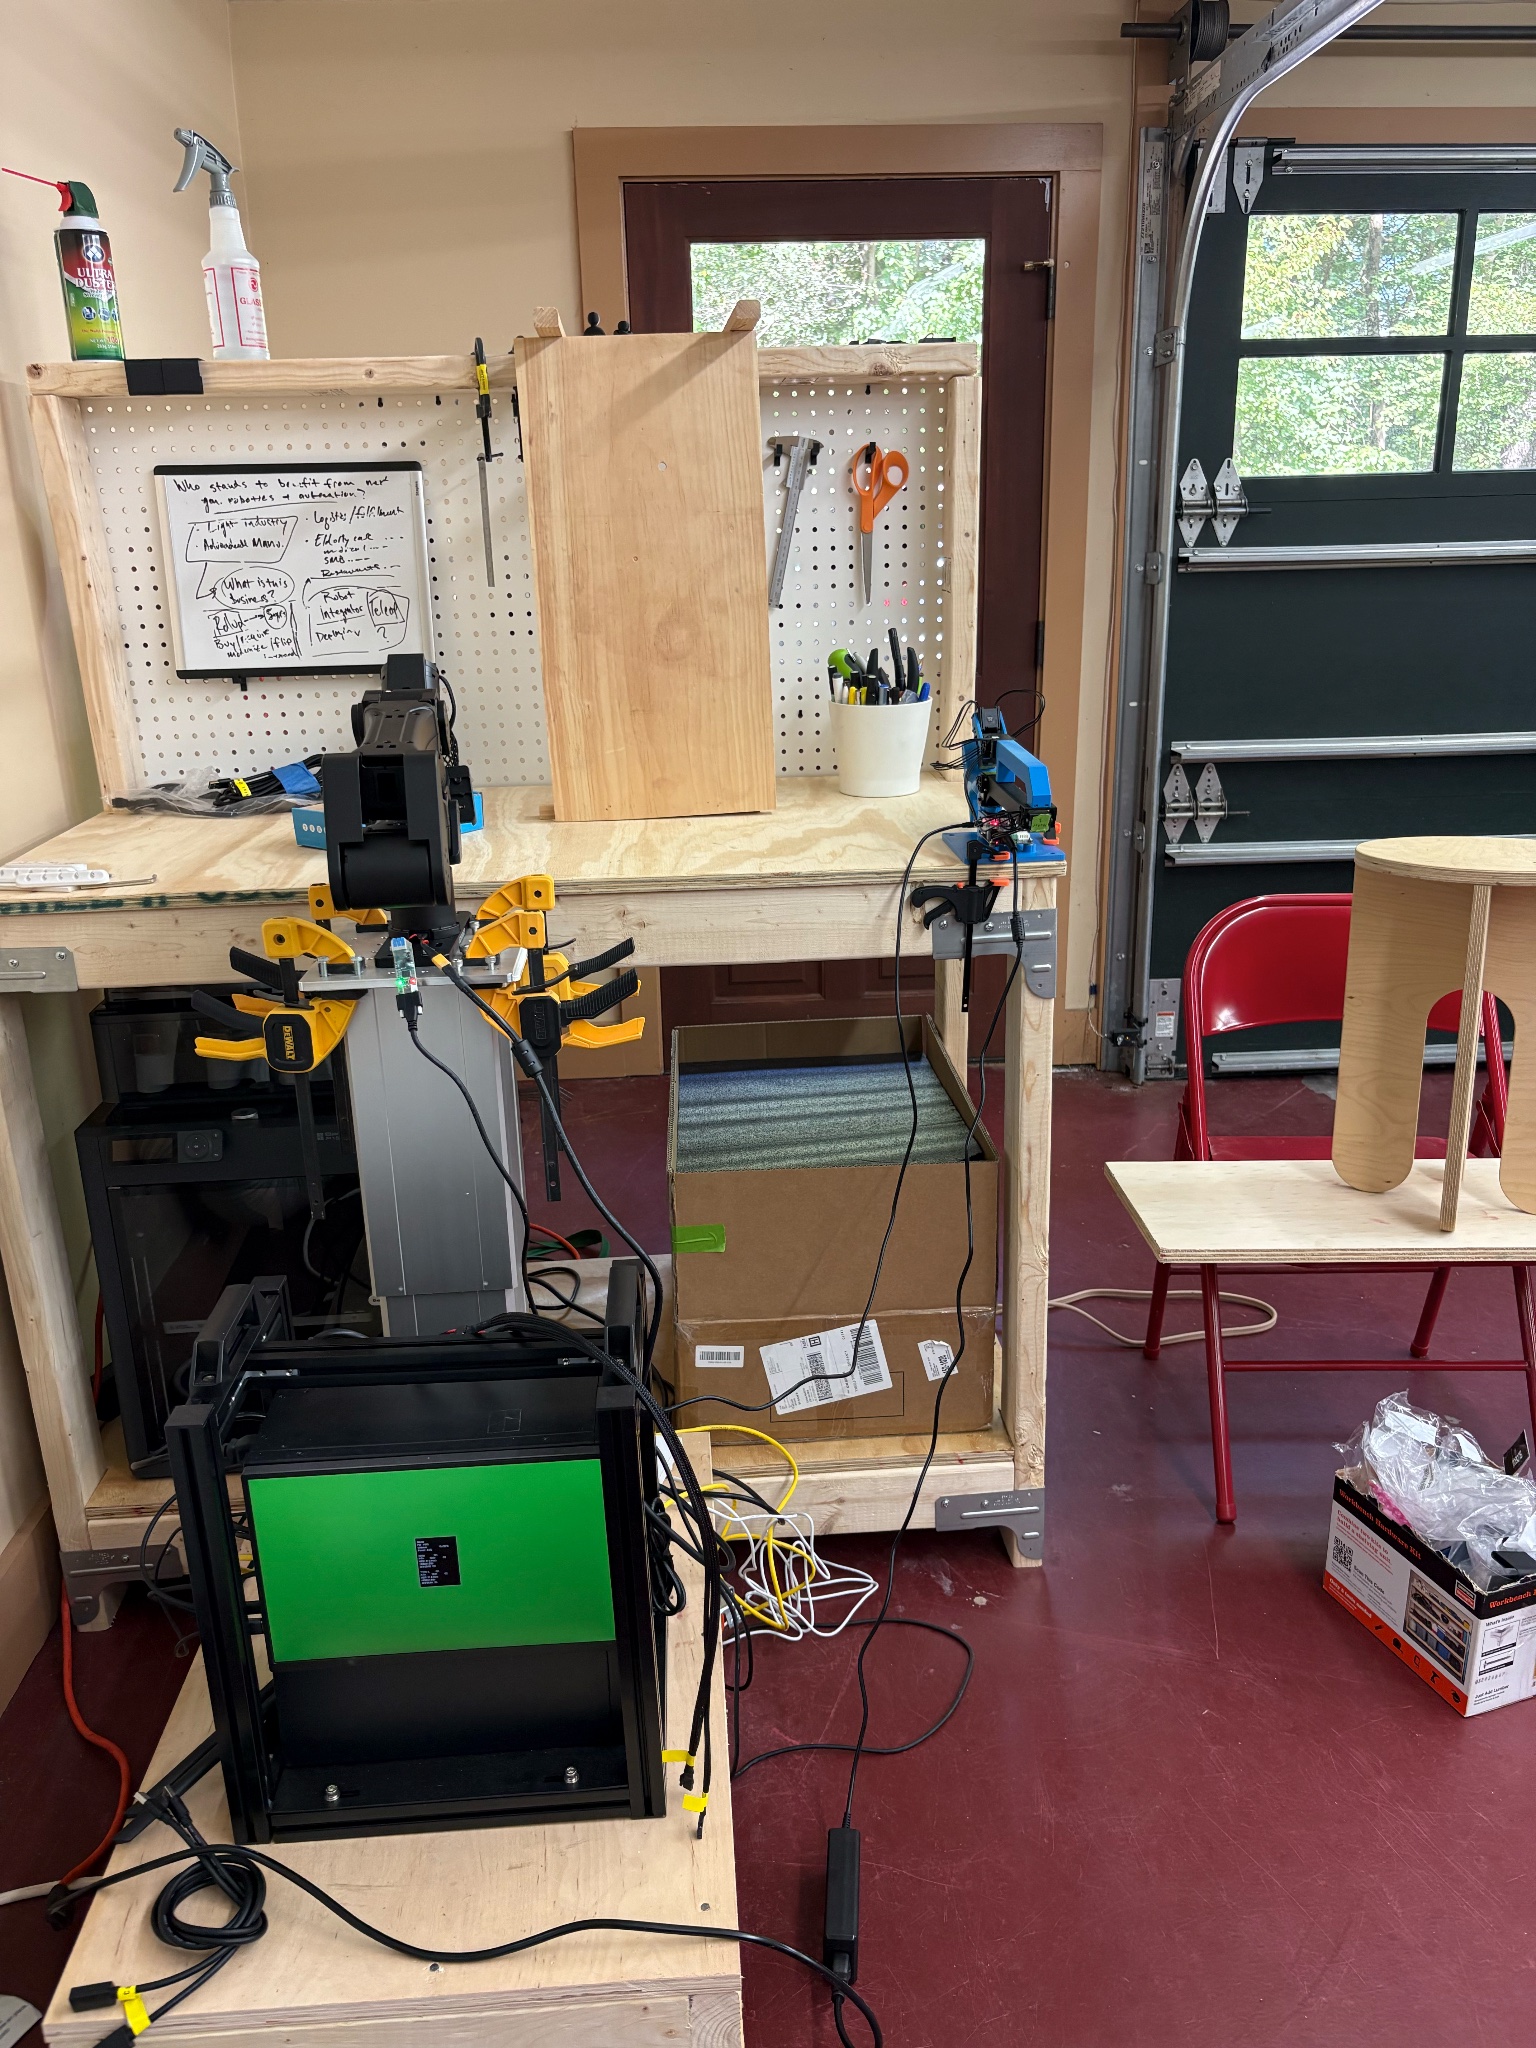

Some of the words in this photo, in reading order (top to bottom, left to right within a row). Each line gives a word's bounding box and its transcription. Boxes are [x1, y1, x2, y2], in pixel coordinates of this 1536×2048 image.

[77, 267, 112, 281] ULTRA
[76, 278, 115, 290] DUSTE
[173, 479, 201, 492] Who
[209, 480, 247, 492] stands
[255, 480, 268, 489] to
[323, 478, 355, 489] from
[223, 577, 255, 591] What
[323, 590, 355, 604] Robot
[1339, 1489, 1374, 1521] Workbench
[1375, 1517, 1409, 1550] Hardware
[1409, 1545, 1422, 1560] Kit
[1489, 1590, 1531, 1609] Workbench
